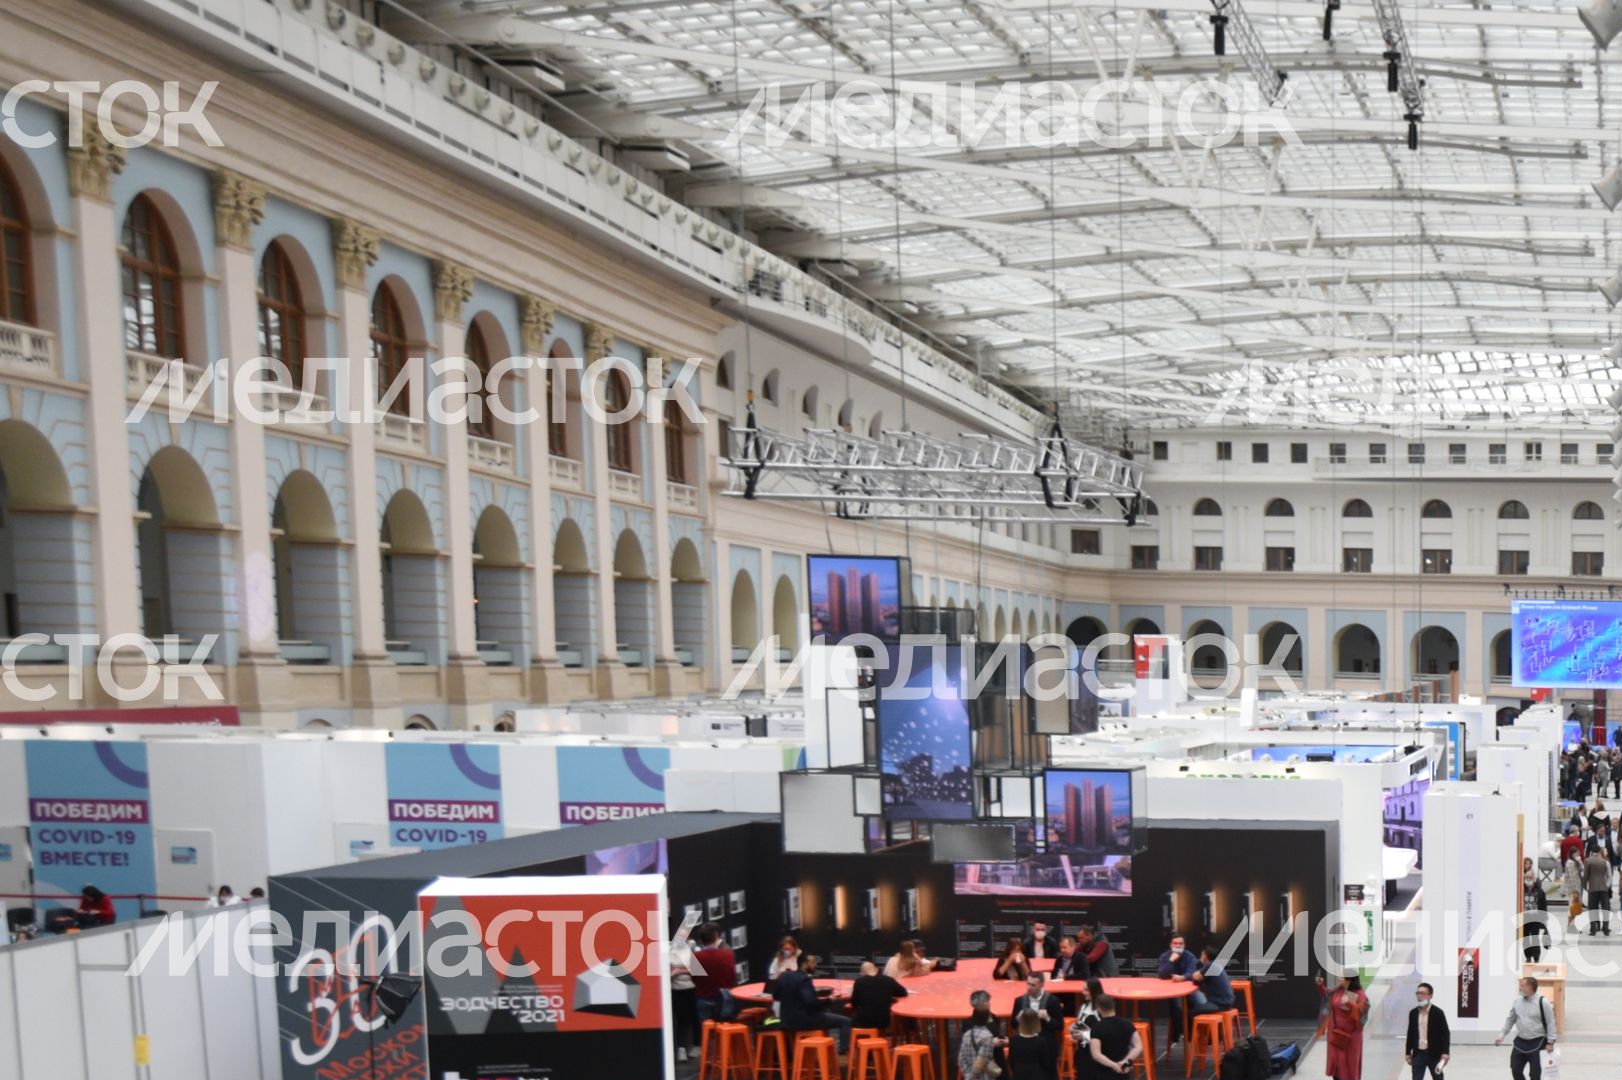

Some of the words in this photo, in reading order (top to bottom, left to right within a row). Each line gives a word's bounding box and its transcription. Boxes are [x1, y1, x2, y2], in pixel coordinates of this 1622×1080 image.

[35, 802, 142, 821] ПОБЕДИМ
[394, 803, 494, 821] ПОБЕДИМ
[39, 828, 136, 844] COVID-19
[396, 828, 487, 843] COVID-19
[40, 851, 129, 866] ВМЕСТЕ!
[439, 994, 565, 1012] ЗОДЧЕСТВО
